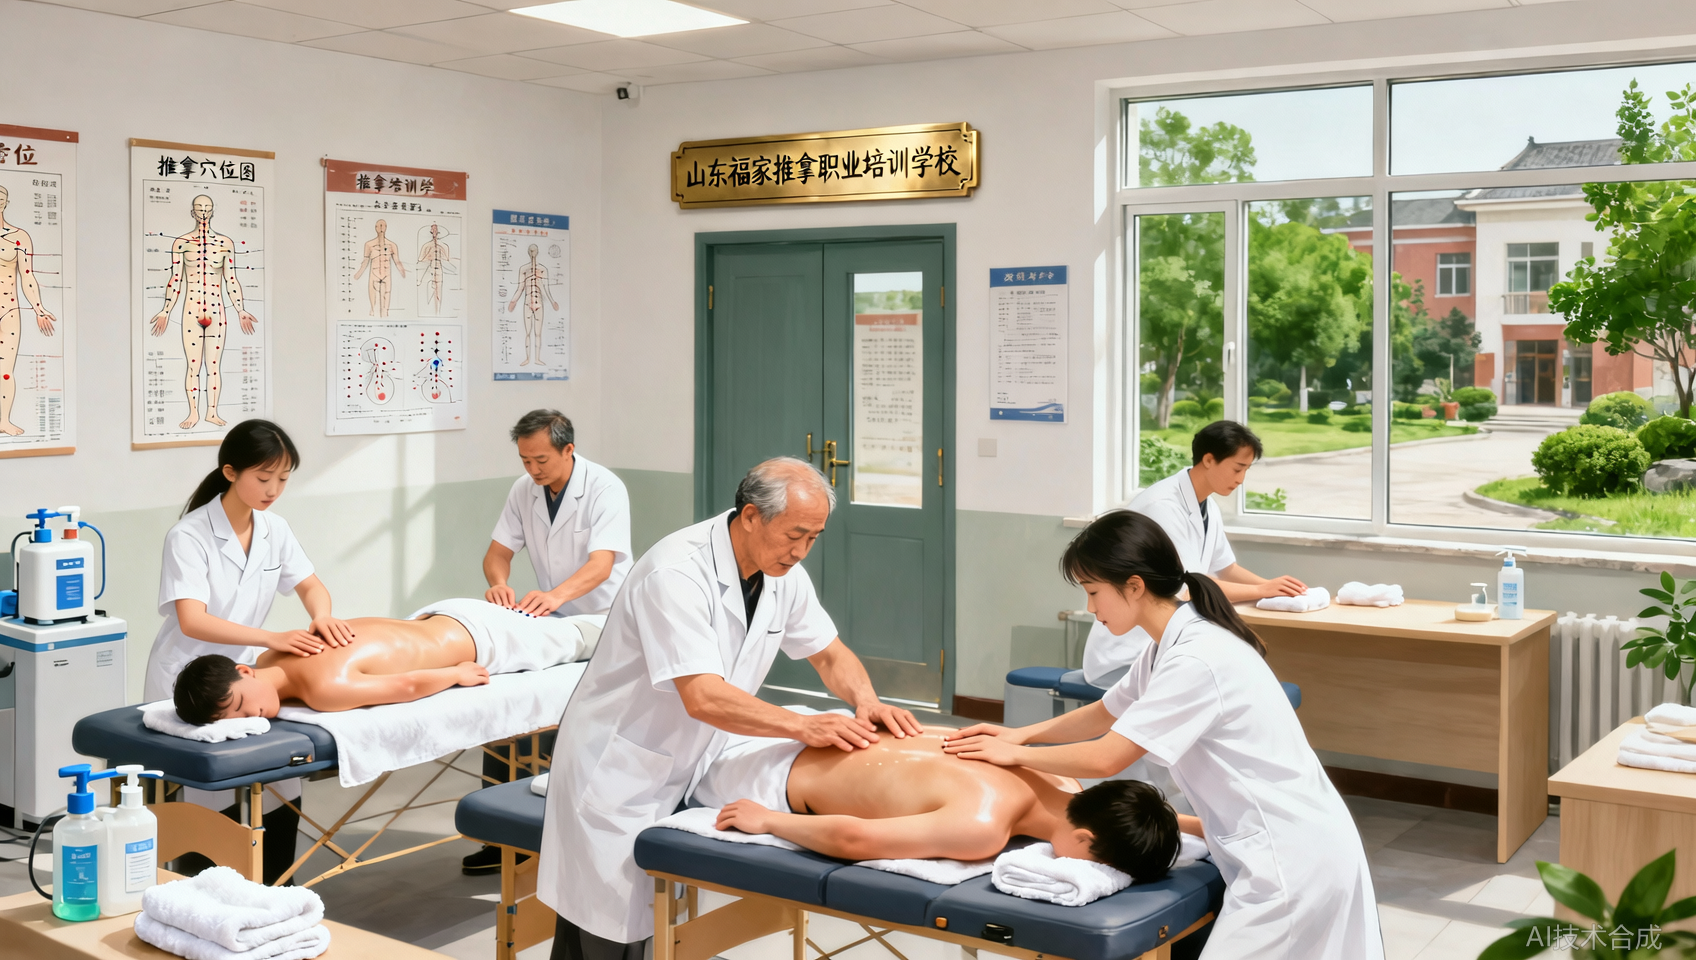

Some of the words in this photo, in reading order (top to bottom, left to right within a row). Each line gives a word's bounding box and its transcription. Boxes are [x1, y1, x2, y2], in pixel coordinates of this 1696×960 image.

[157, 154, 255, 182] 推拿穴位图
[686, 144, 962, 188] 山东福家推拿职业培训学校
